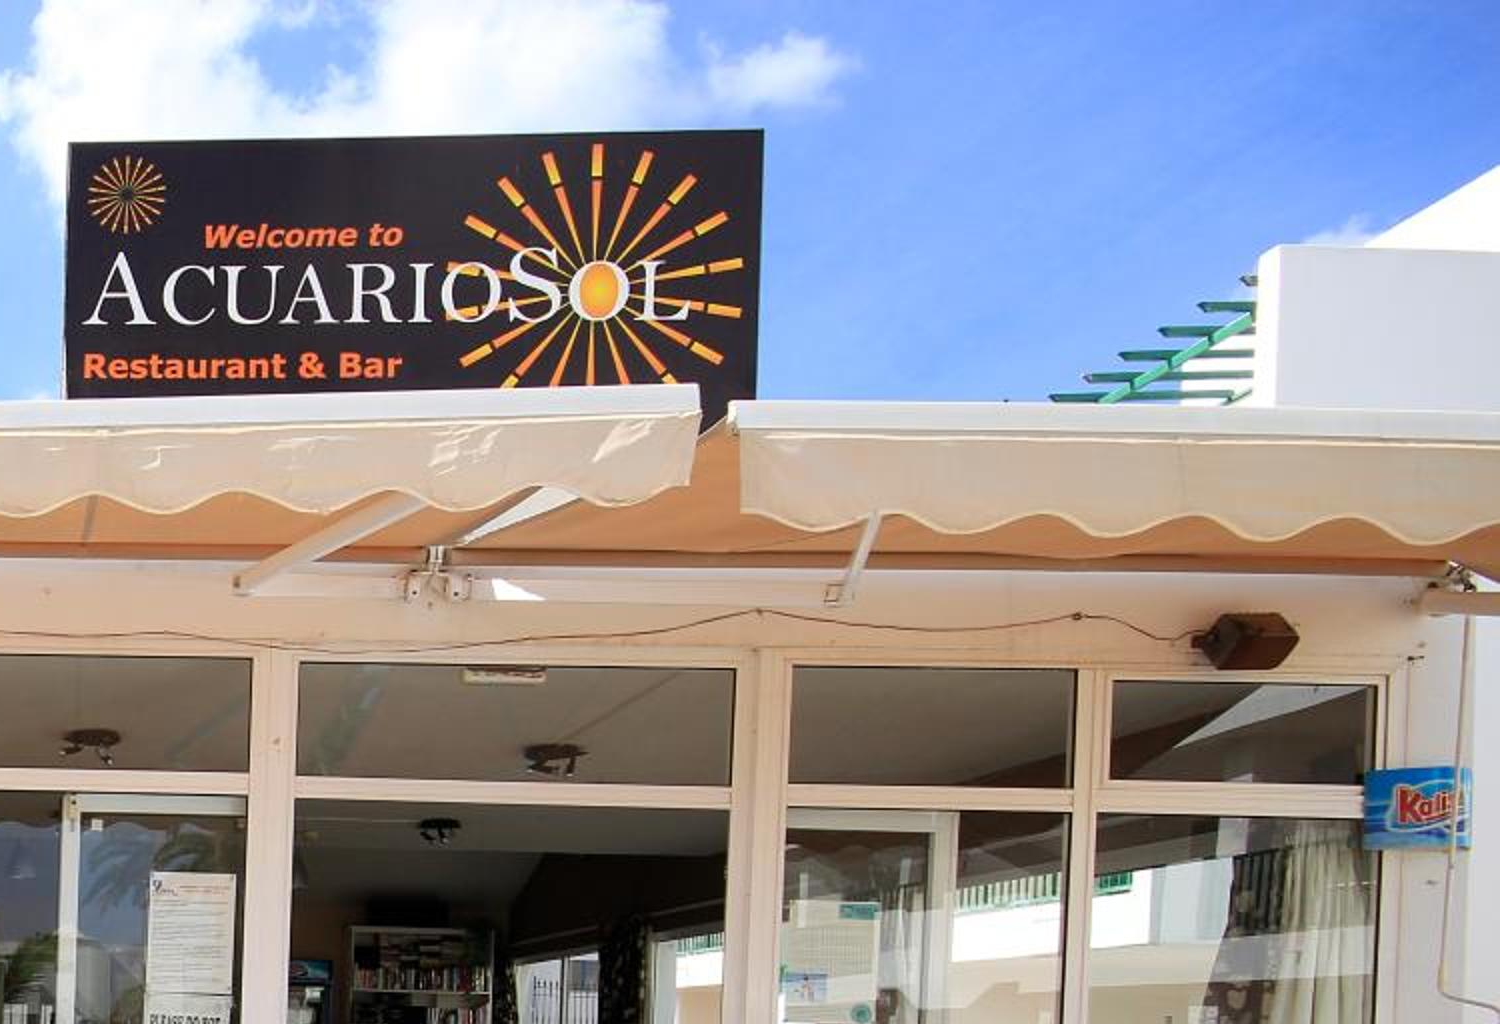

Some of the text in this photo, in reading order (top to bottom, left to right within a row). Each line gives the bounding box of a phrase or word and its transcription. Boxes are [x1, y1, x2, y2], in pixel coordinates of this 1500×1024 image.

[203, 222, 404, 249] Welcome to
[82, 351, 403, 379] Restaurant & Bar
[1396, 785, 1465, 825] Kali
